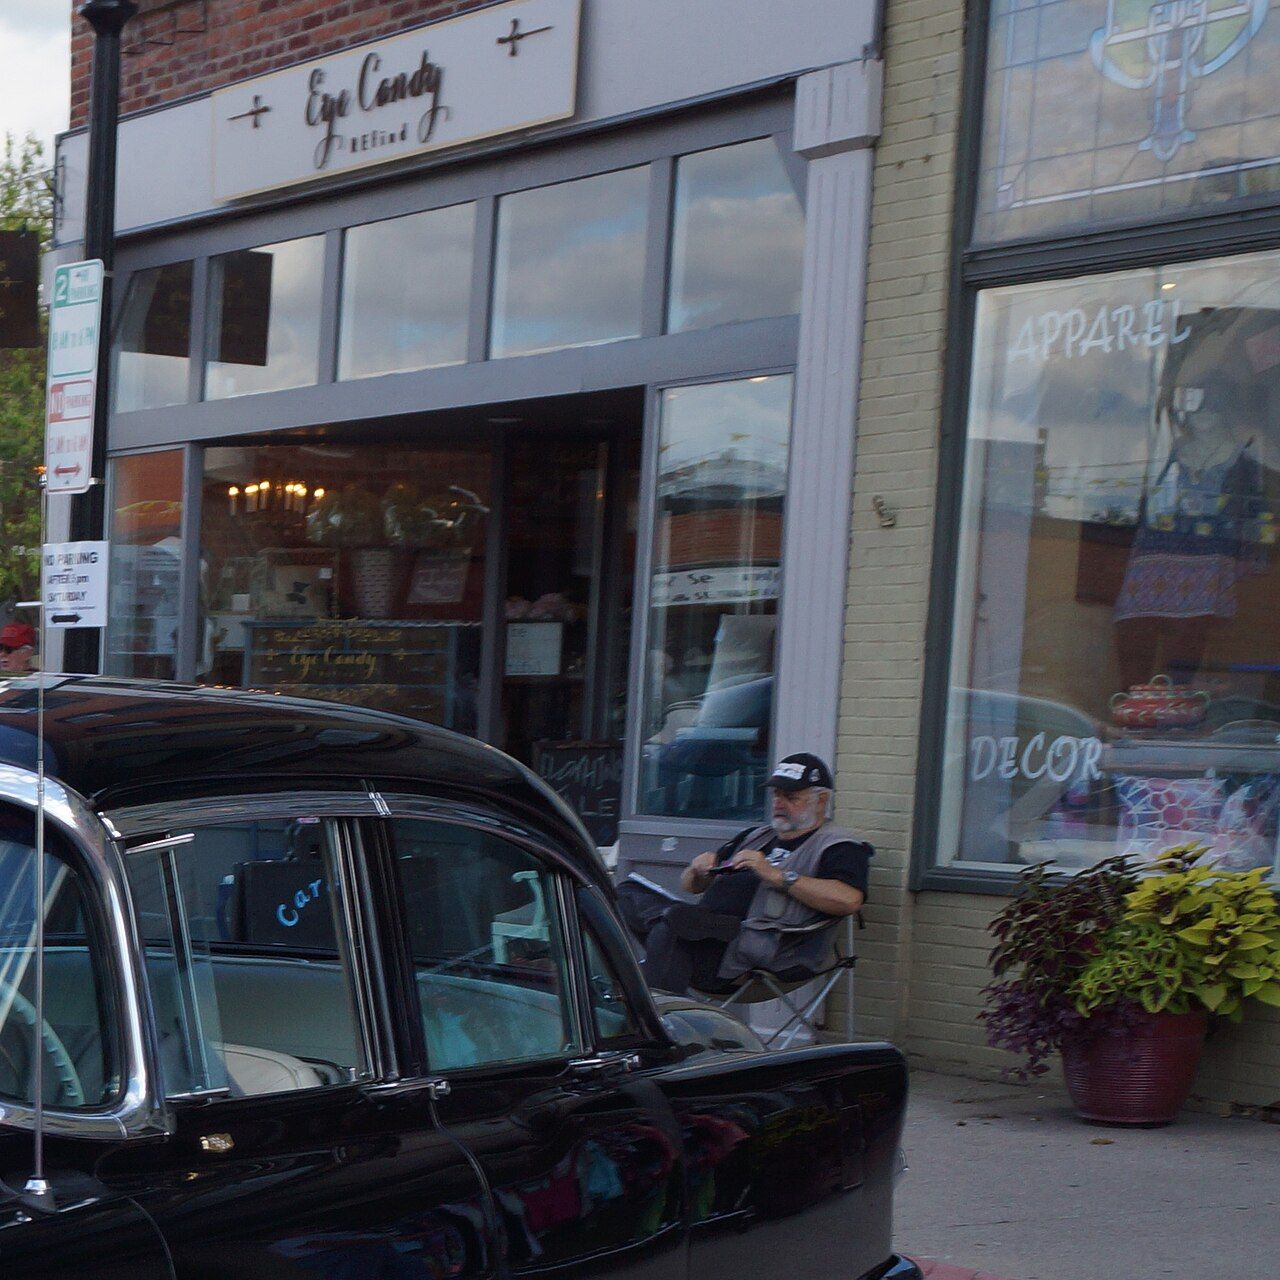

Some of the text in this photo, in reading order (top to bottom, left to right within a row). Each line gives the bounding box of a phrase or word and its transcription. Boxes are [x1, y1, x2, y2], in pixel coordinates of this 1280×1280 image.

[306, 50, 451, 169] Eye Candy
[55, 274, 68, 301] 2
[1007, 299, 1191, 364] APPAREL
[58, 552, 99, 566] PARKING
[971, 731, 1104, 783] DECOR
